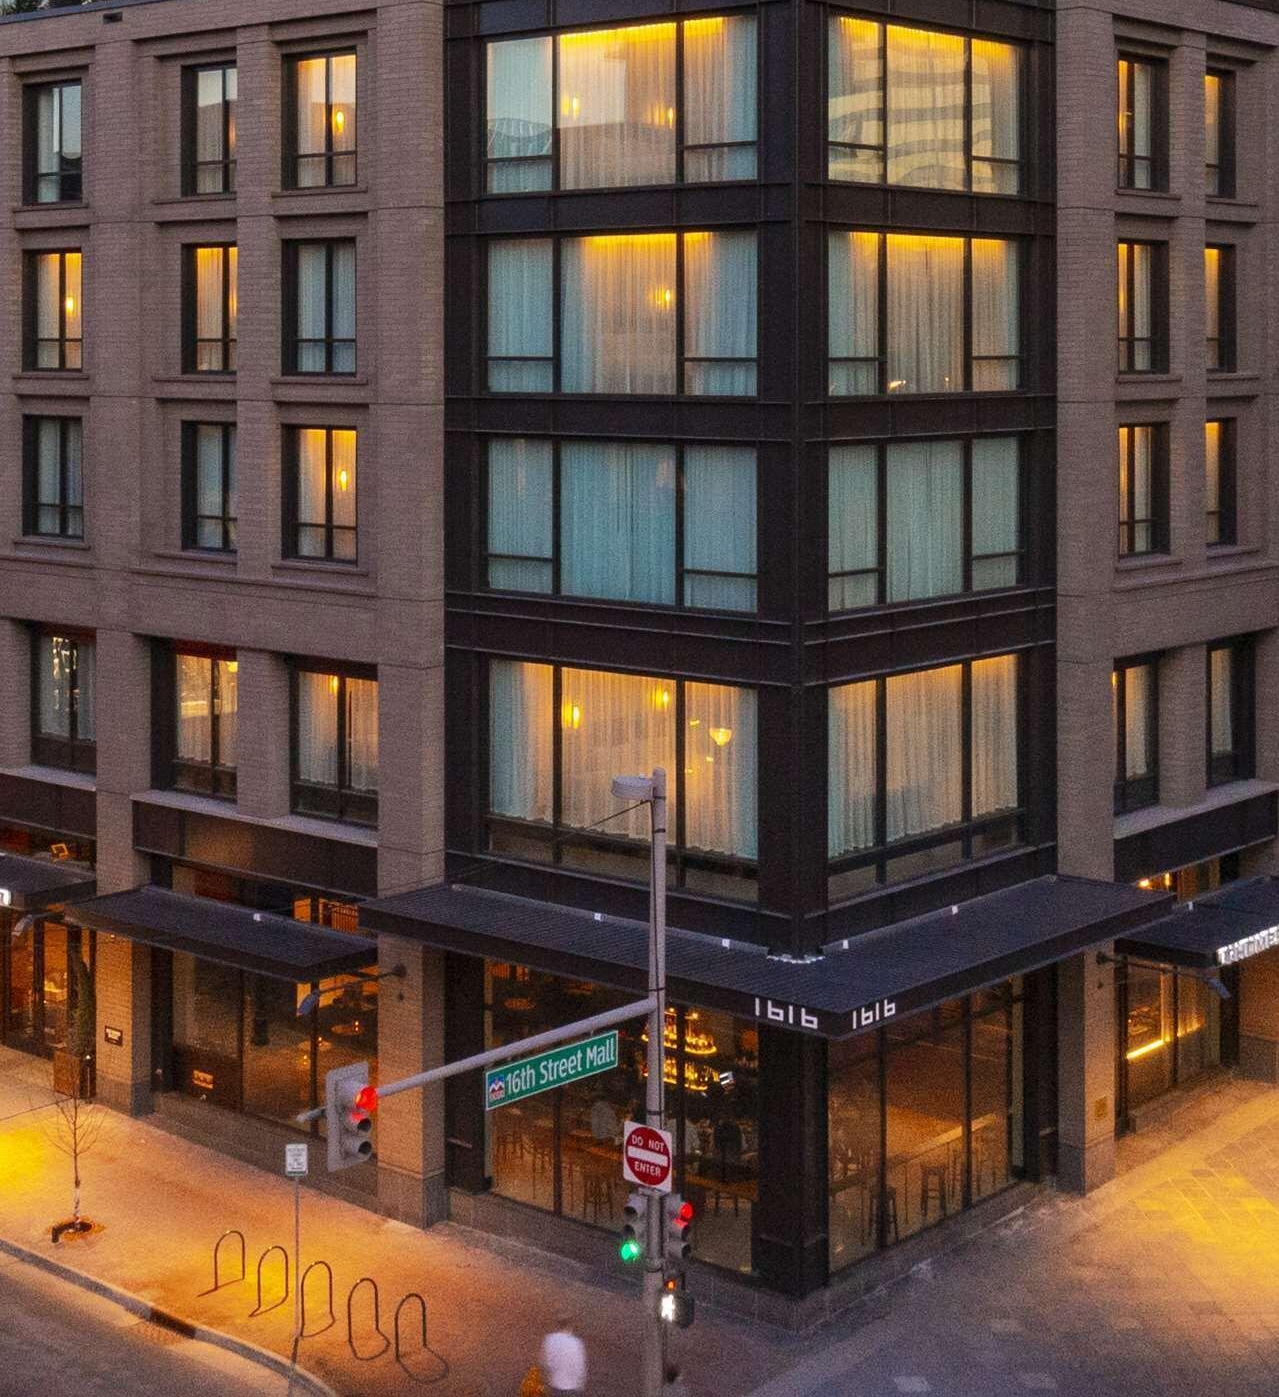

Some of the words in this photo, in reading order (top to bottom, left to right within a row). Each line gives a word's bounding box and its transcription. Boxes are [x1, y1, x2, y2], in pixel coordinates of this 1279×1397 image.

[754, 997, 819, 1030] 1616
[852, 999, 896, 1030] 1616
[505, 1065, 536, 1095] 16th
[539, 1050, 583, 1084] Street
[585, 1038, 615, 1069] Mall
[631, 1134, 644, 1146] DO
[648, 1139, 665, 1153] NOT
[634, 1161, 662, 1177] ENTER
